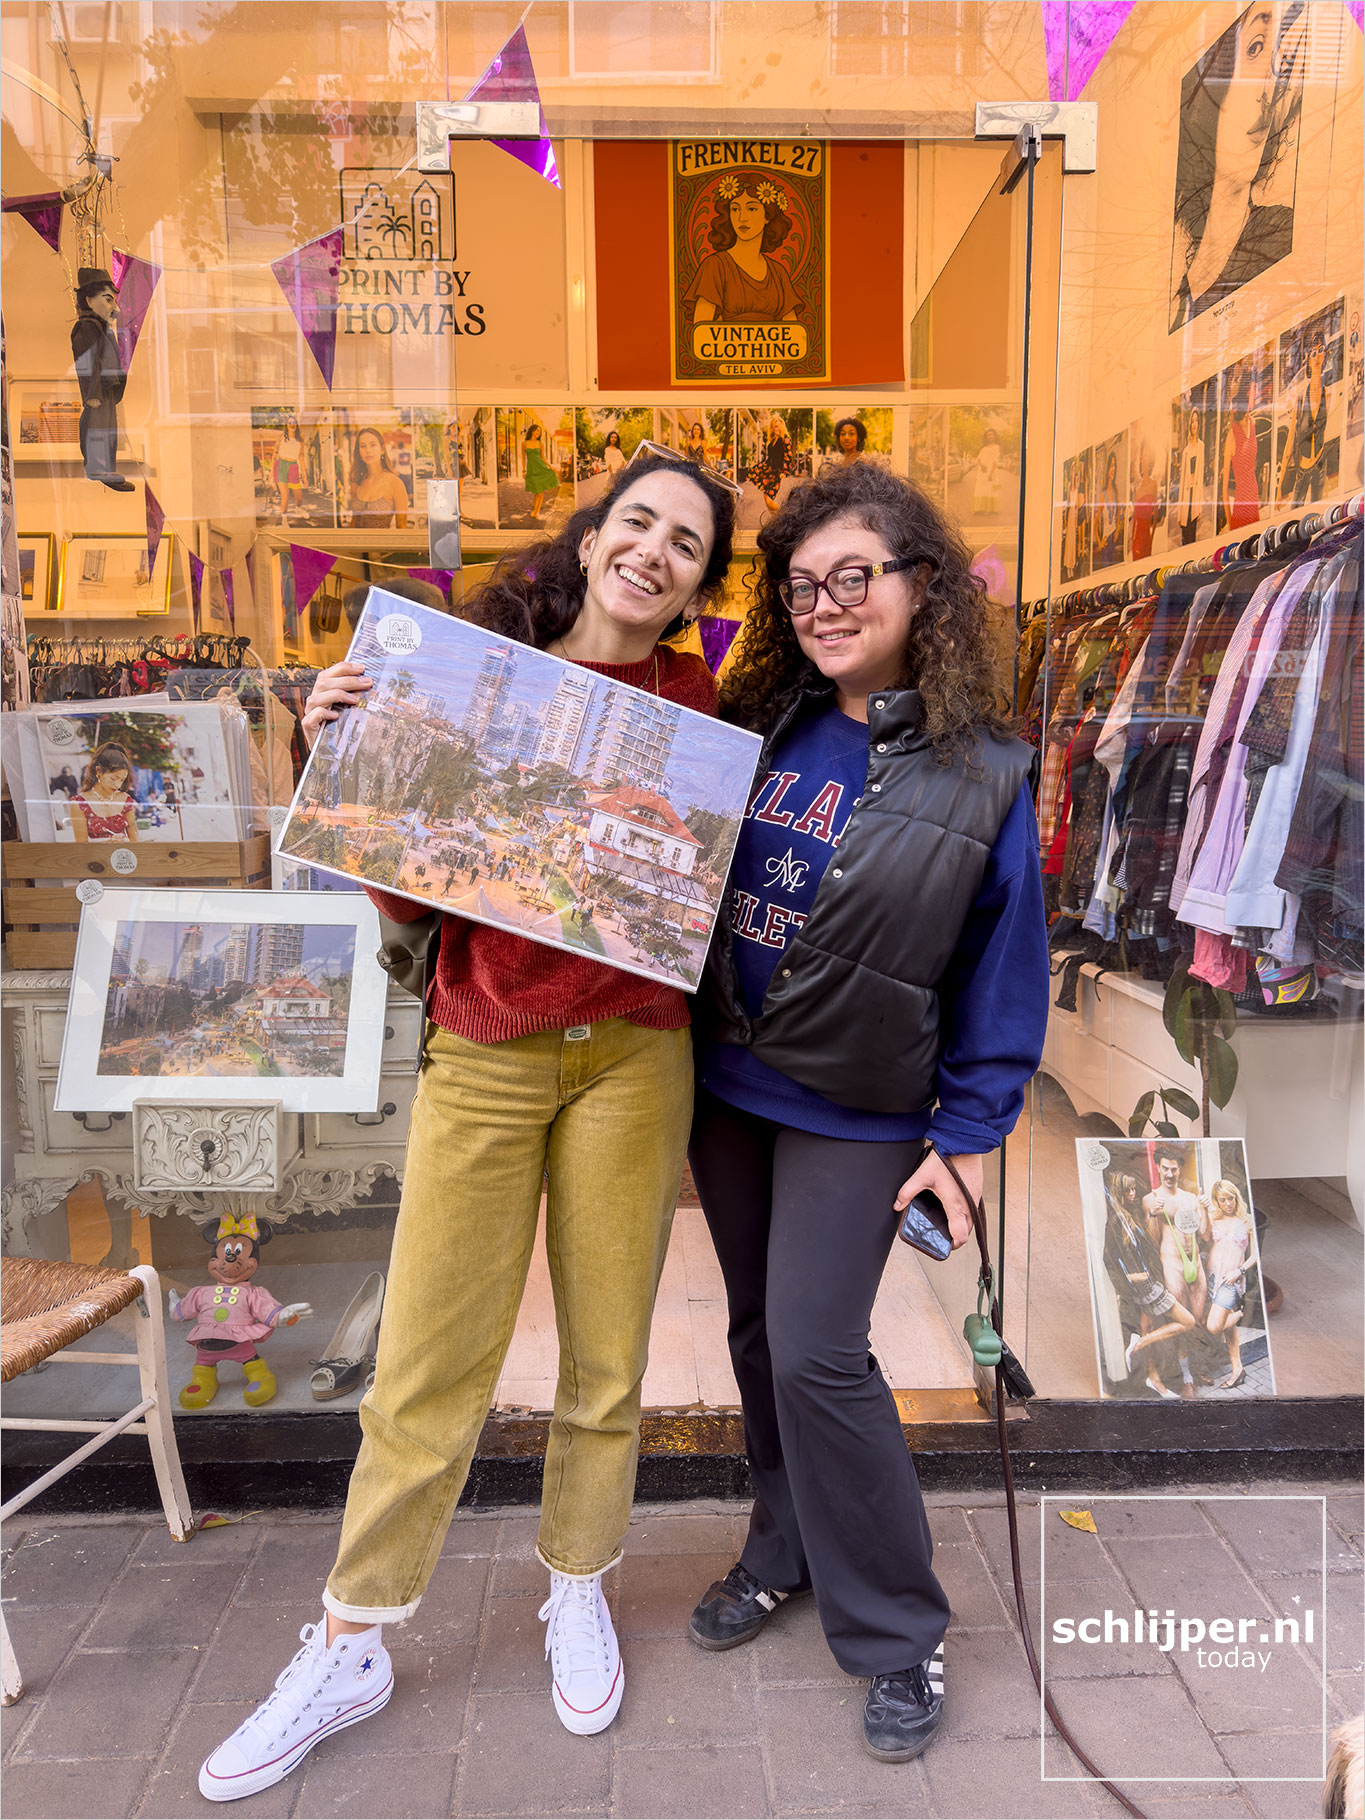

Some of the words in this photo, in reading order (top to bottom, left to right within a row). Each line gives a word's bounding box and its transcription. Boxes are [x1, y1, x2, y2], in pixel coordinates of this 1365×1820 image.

[681, 141, 786, 172] FRENKEL
[790, 145, 820, 172] 27
[432, 270, 472, 297] BY
[336, 302, 487, 336] HOMAS
[709, 327, 792, 341] VINTAGE
[700, 343, 800, 358] CLOTHING
[726, 365, 746, 374] TEL
[749, 364, 777, 374] AVIV
[383, 641, 418, 650] THOMAS
[732, 888, 808, 949] HLET
